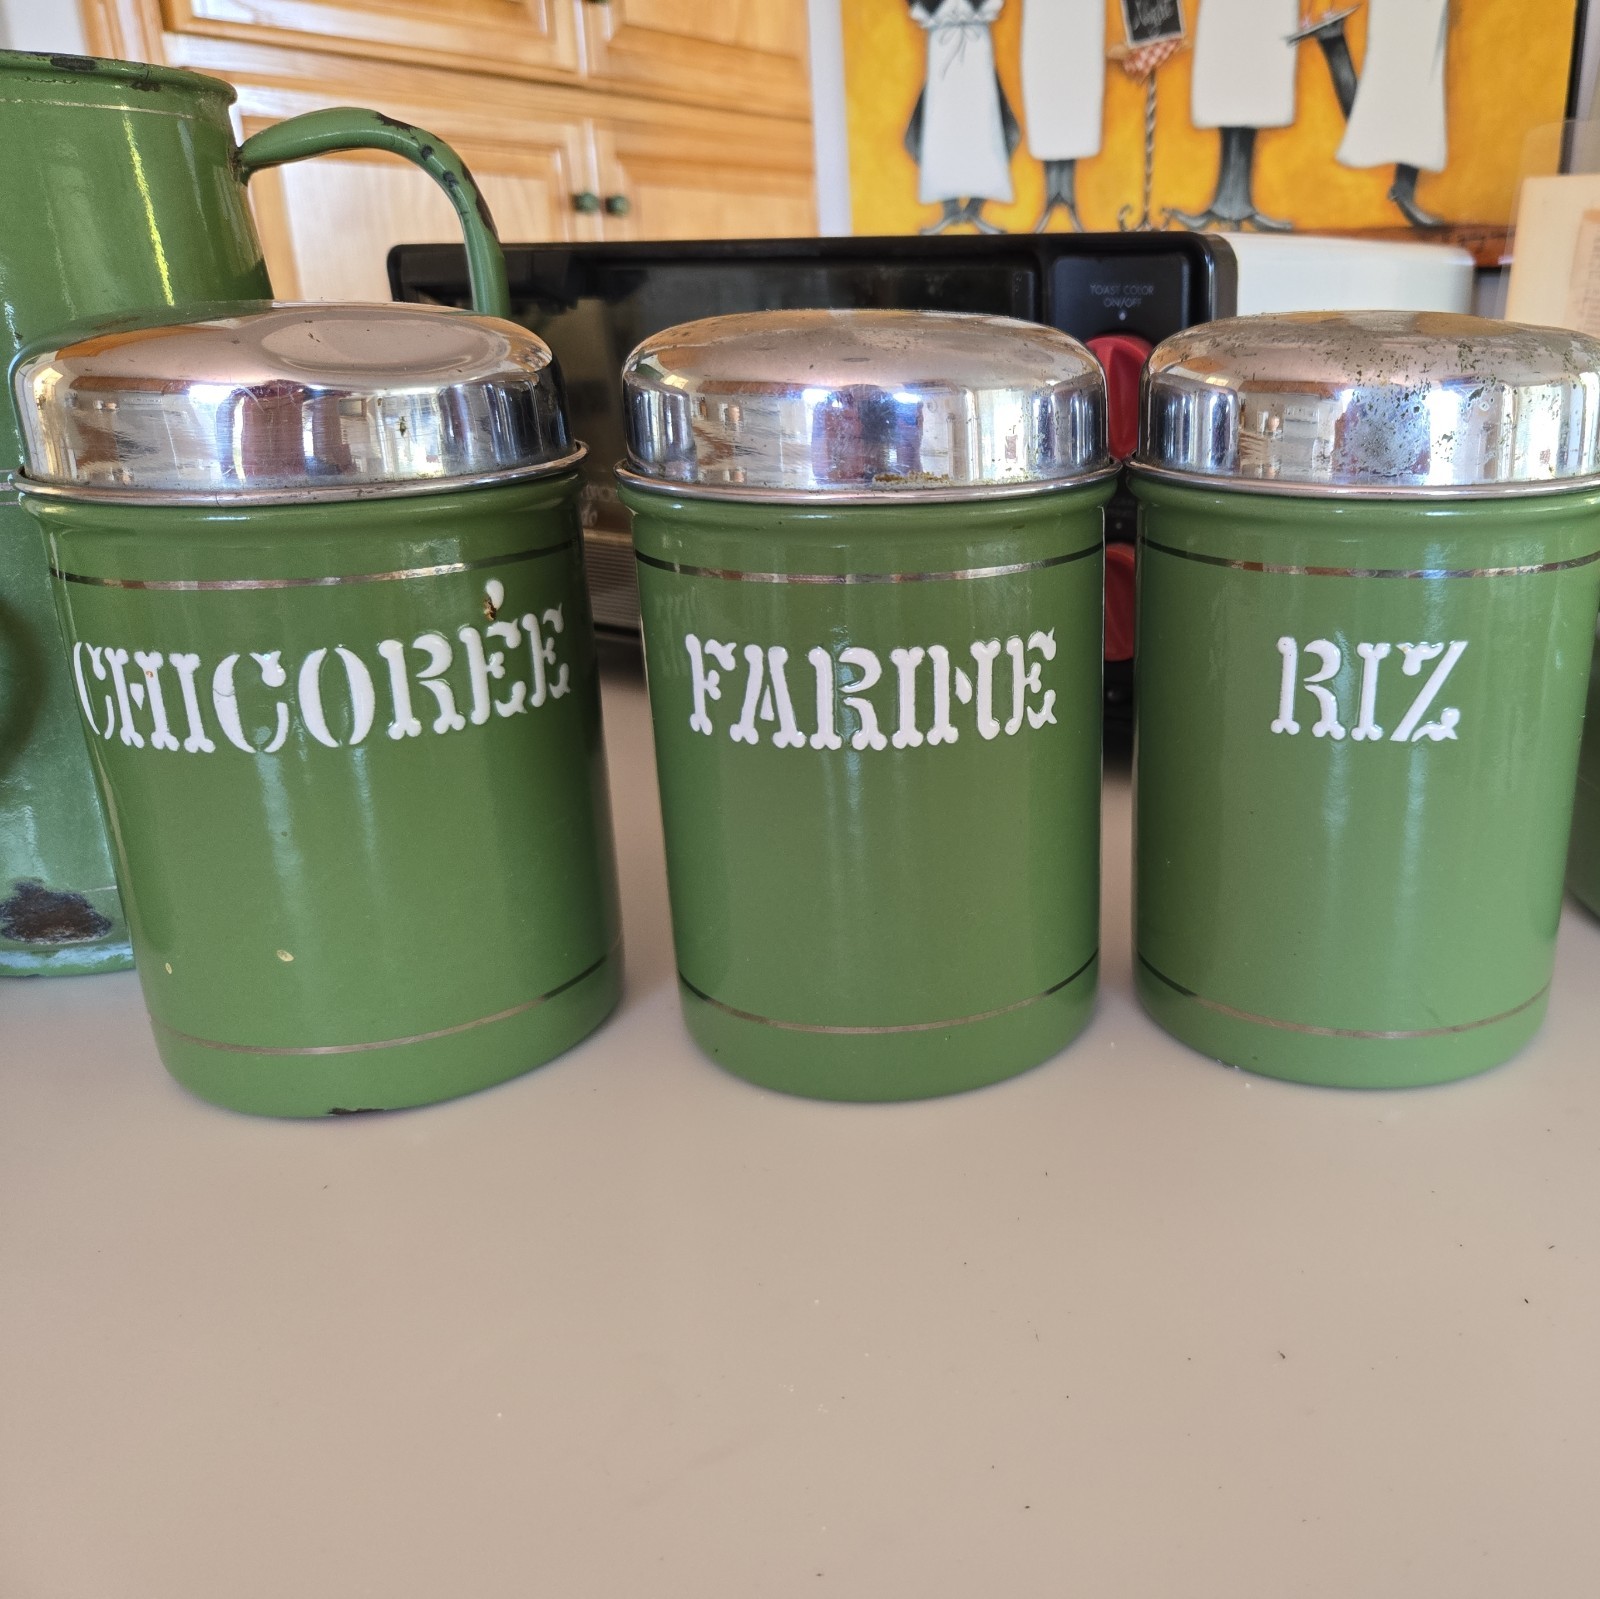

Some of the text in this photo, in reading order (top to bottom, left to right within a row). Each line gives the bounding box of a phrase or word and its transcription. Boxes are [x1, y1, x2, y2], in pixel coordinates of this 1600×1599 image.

[1089, 284, 1154, 296] TOAST COLOR
[1103, 297, 1142, 309] ON/OFF
[73, 579, 571, 754] CHICORÉE
[685, 627, 1058, 752] FARINE
[1270, 636, 1469, 742] RIZ
